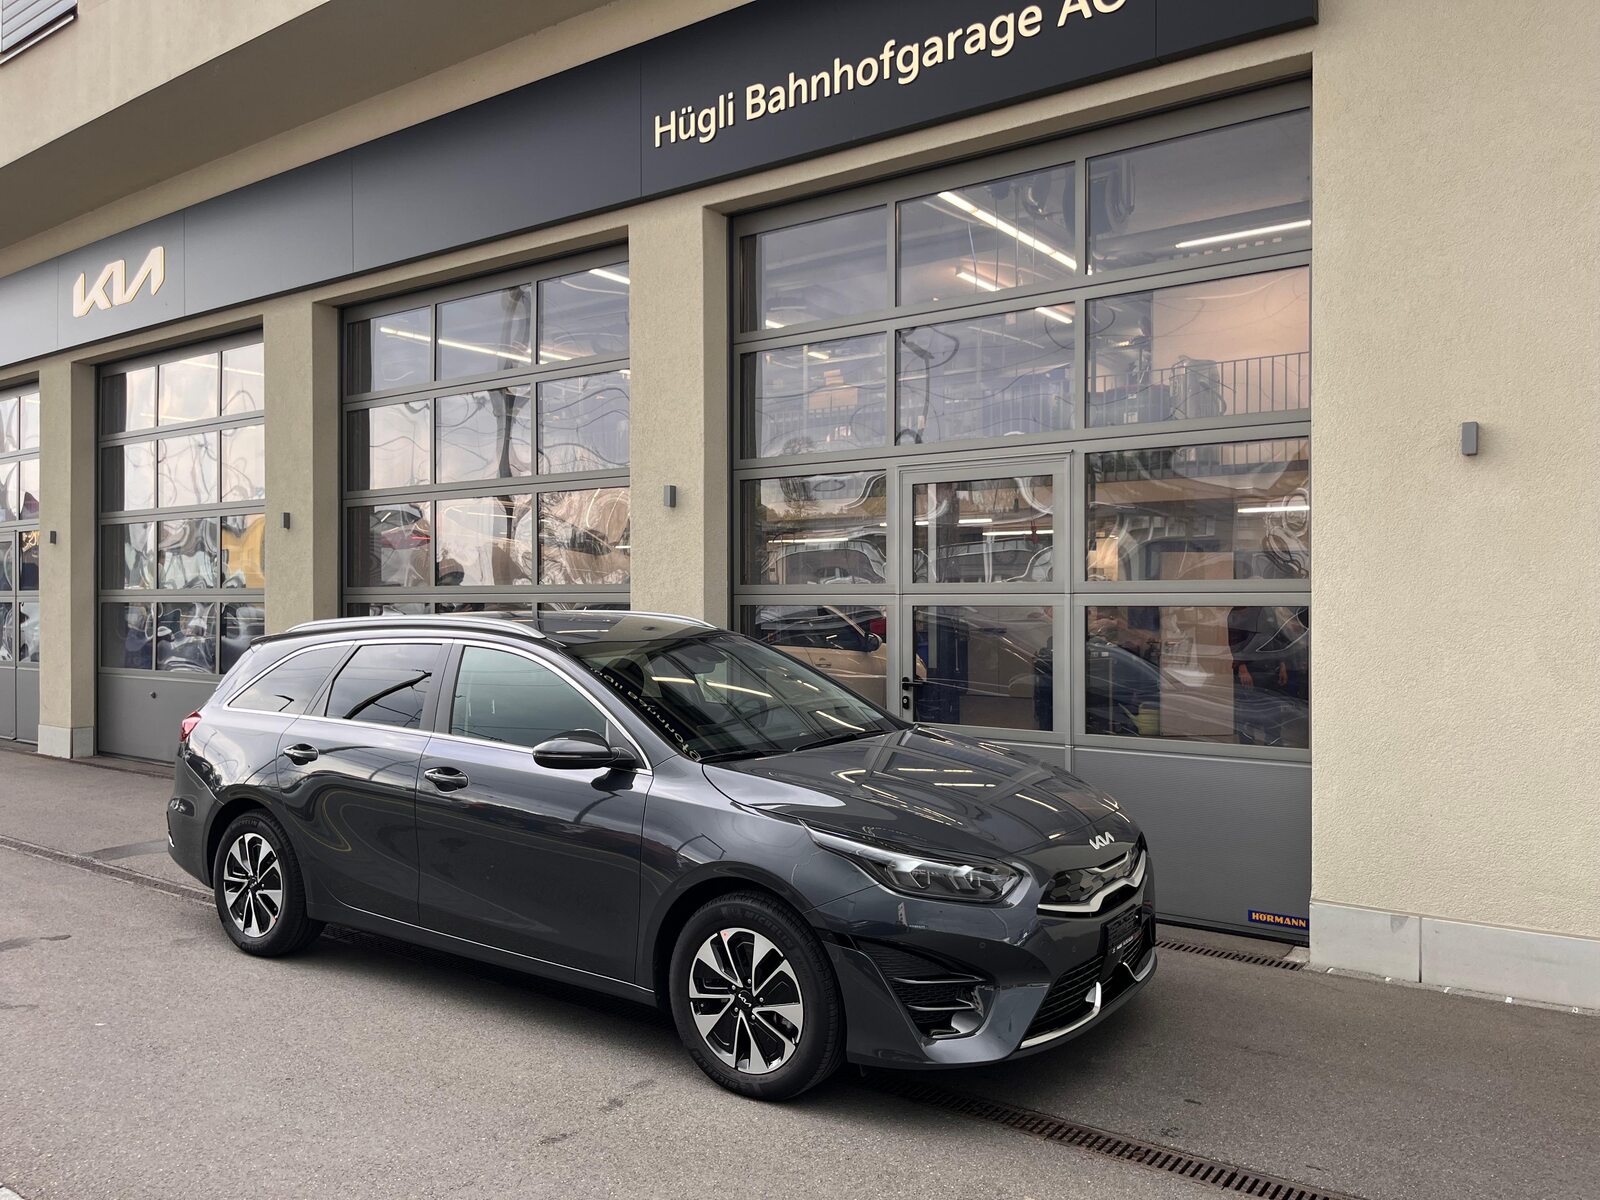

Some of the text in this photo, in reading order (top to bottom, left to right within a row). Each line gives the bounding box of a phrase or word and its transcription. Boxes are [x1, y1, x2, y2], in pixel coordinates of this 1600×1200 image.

[654, 94, 734, 147] Hügli
[745, 3, 1042, 121] Bahnhofgarage
[72, 246, 165, 318] KIA
[1089, 831, 1115, 850] KIA
